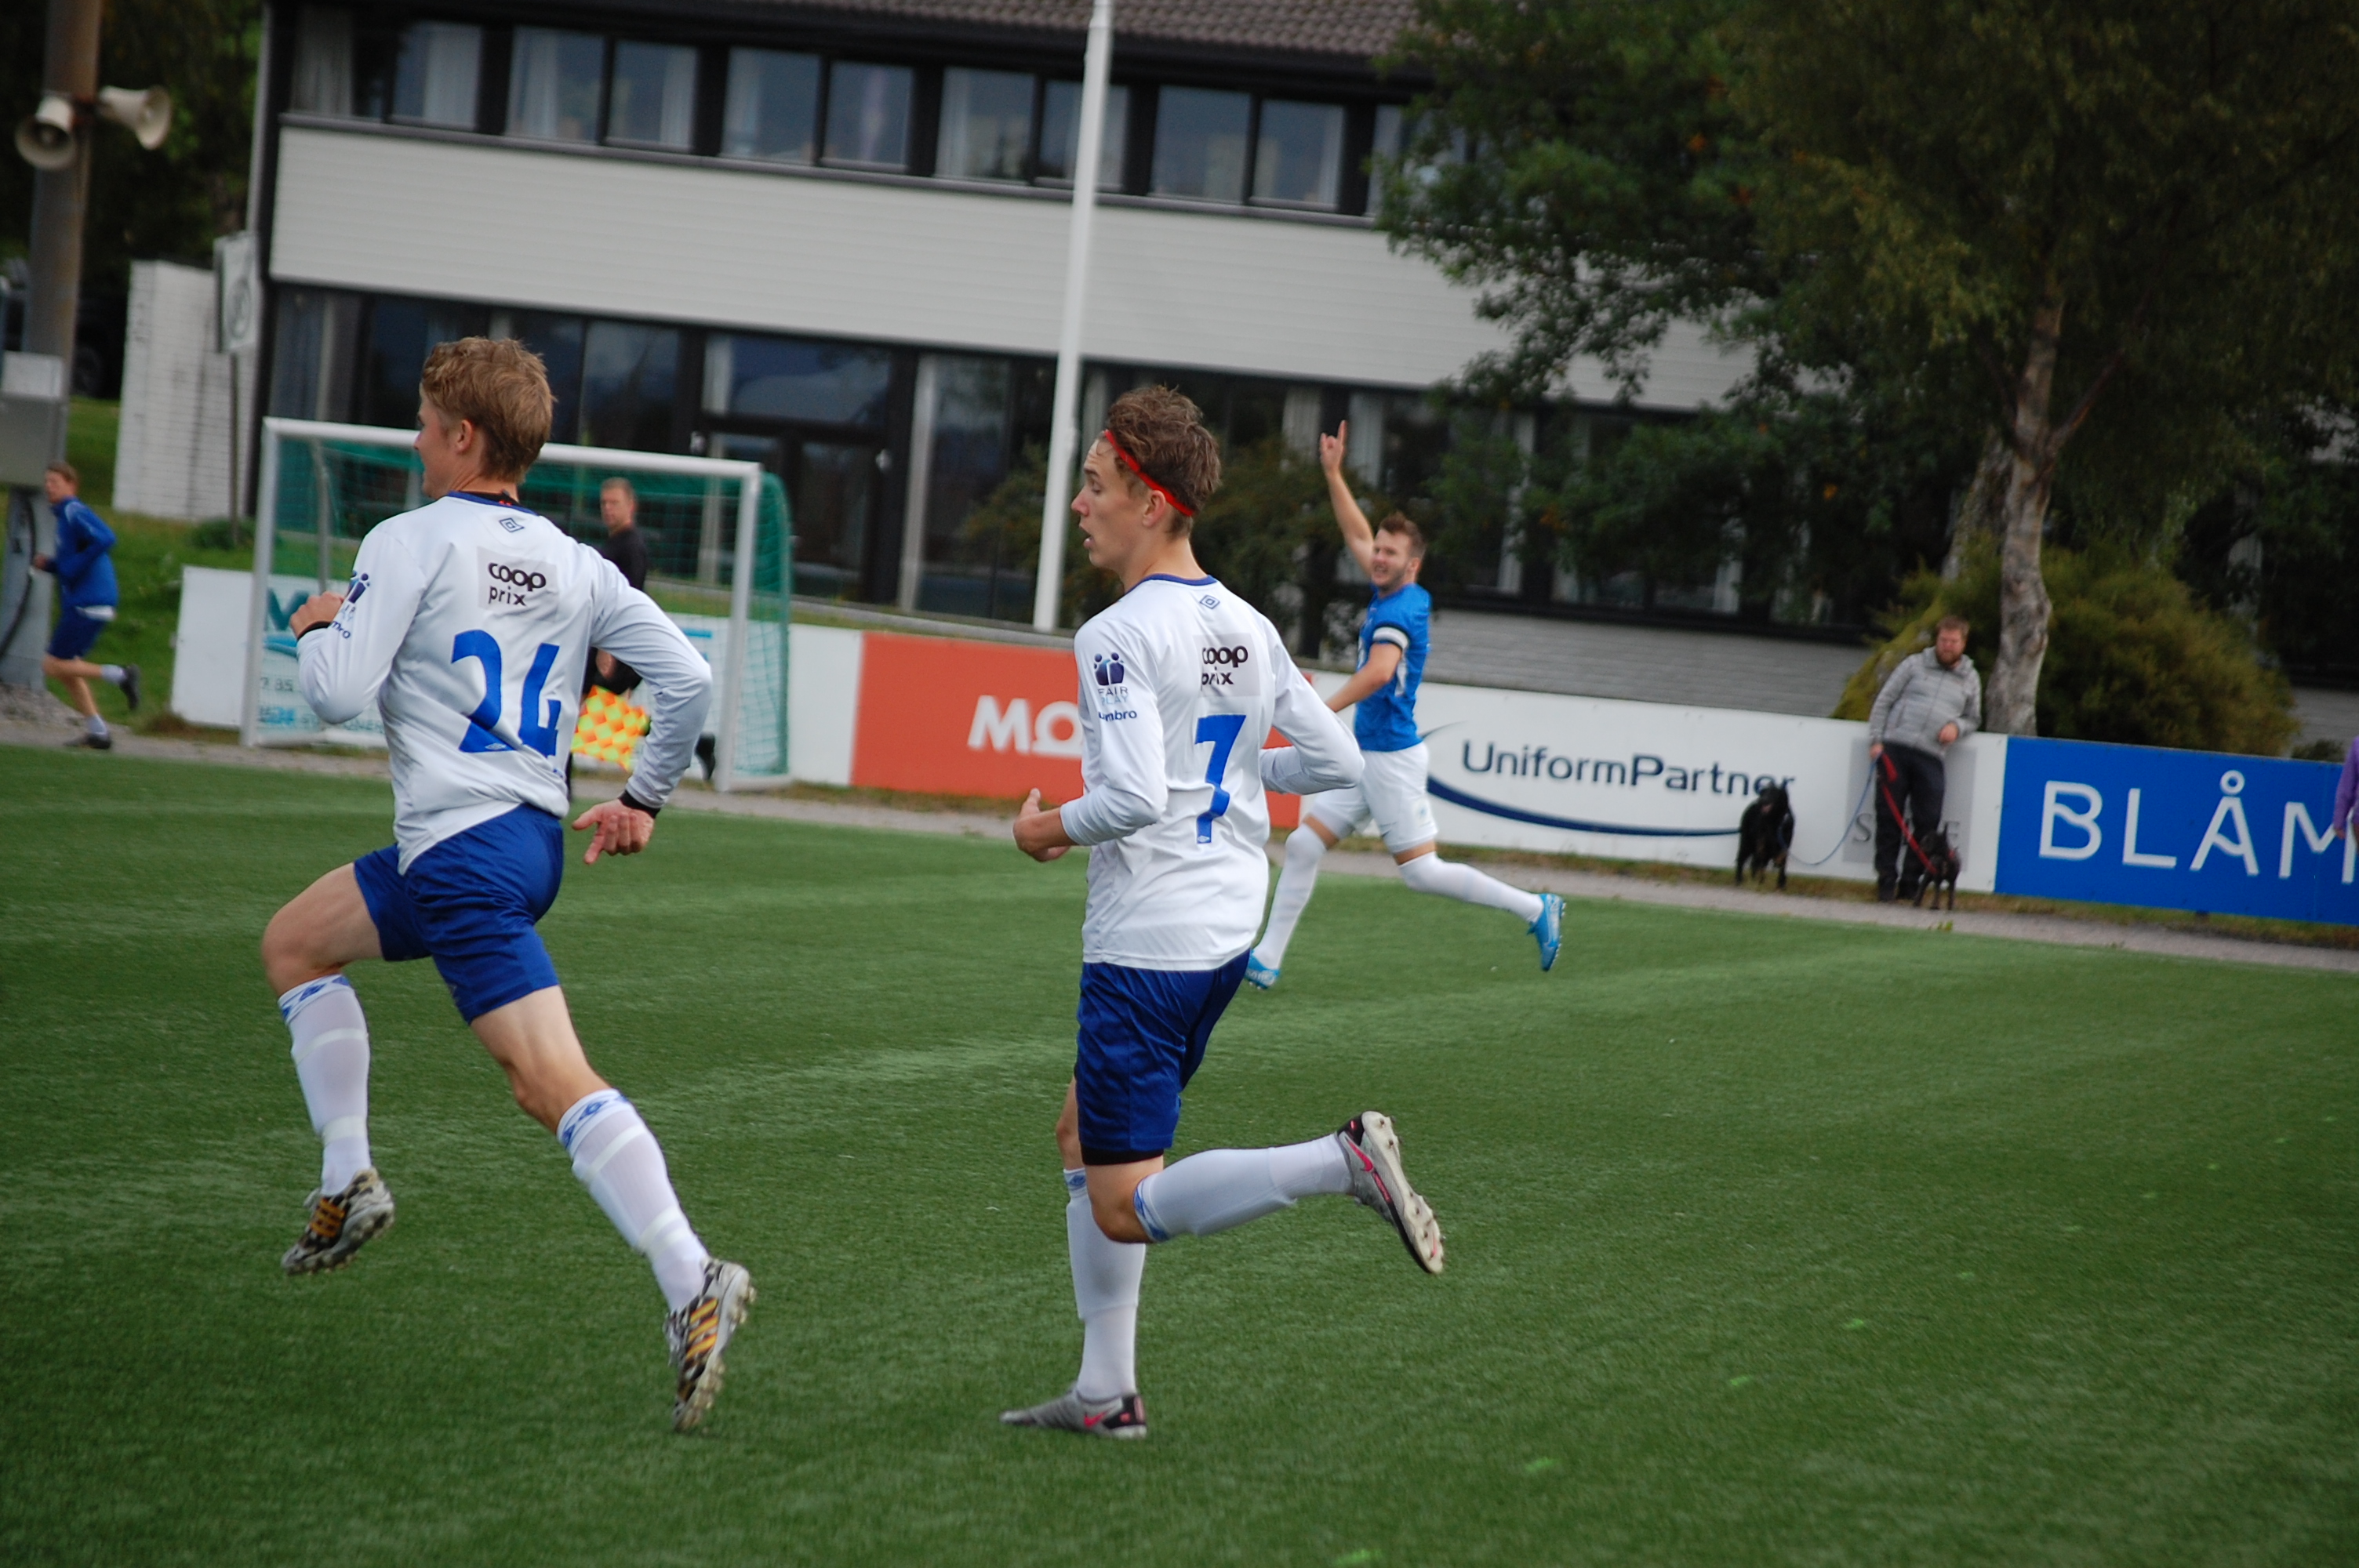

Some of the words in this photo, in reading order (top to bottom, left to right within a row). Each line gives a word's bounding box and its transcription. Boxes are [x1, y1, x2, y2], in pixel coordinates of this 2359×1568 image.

[488, 562, 547, 592] coop
[488, 586, 527, 607] prix
[1201, 645, 1249, 668] coop
[451, 629, 562, 759] 24
[1097, 686, 1129, 696] FAIR
[1098, 710, 1138, 722] umbro
[1194, 714, 1247, 844] 7
